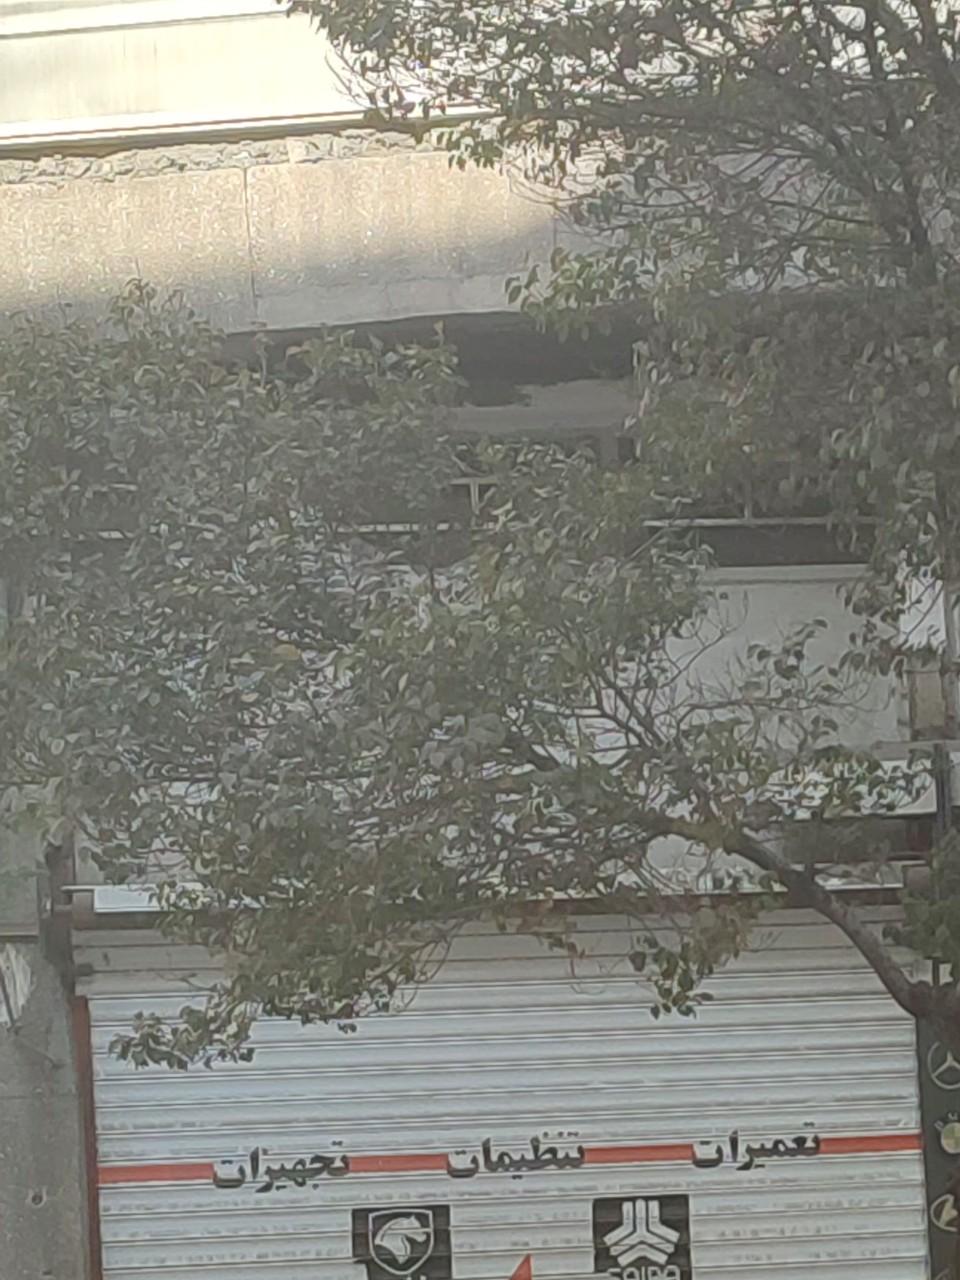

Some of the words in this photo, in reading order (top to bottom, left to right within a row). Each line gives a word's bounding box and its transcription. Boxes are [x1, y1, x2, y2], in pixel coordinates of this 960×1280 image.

[211, 1140, 350, 1192] تجهیزات
[446, 1131, 585, 1180] تنظیمات
[690, 1122, 820, 1171] تعمیرات
